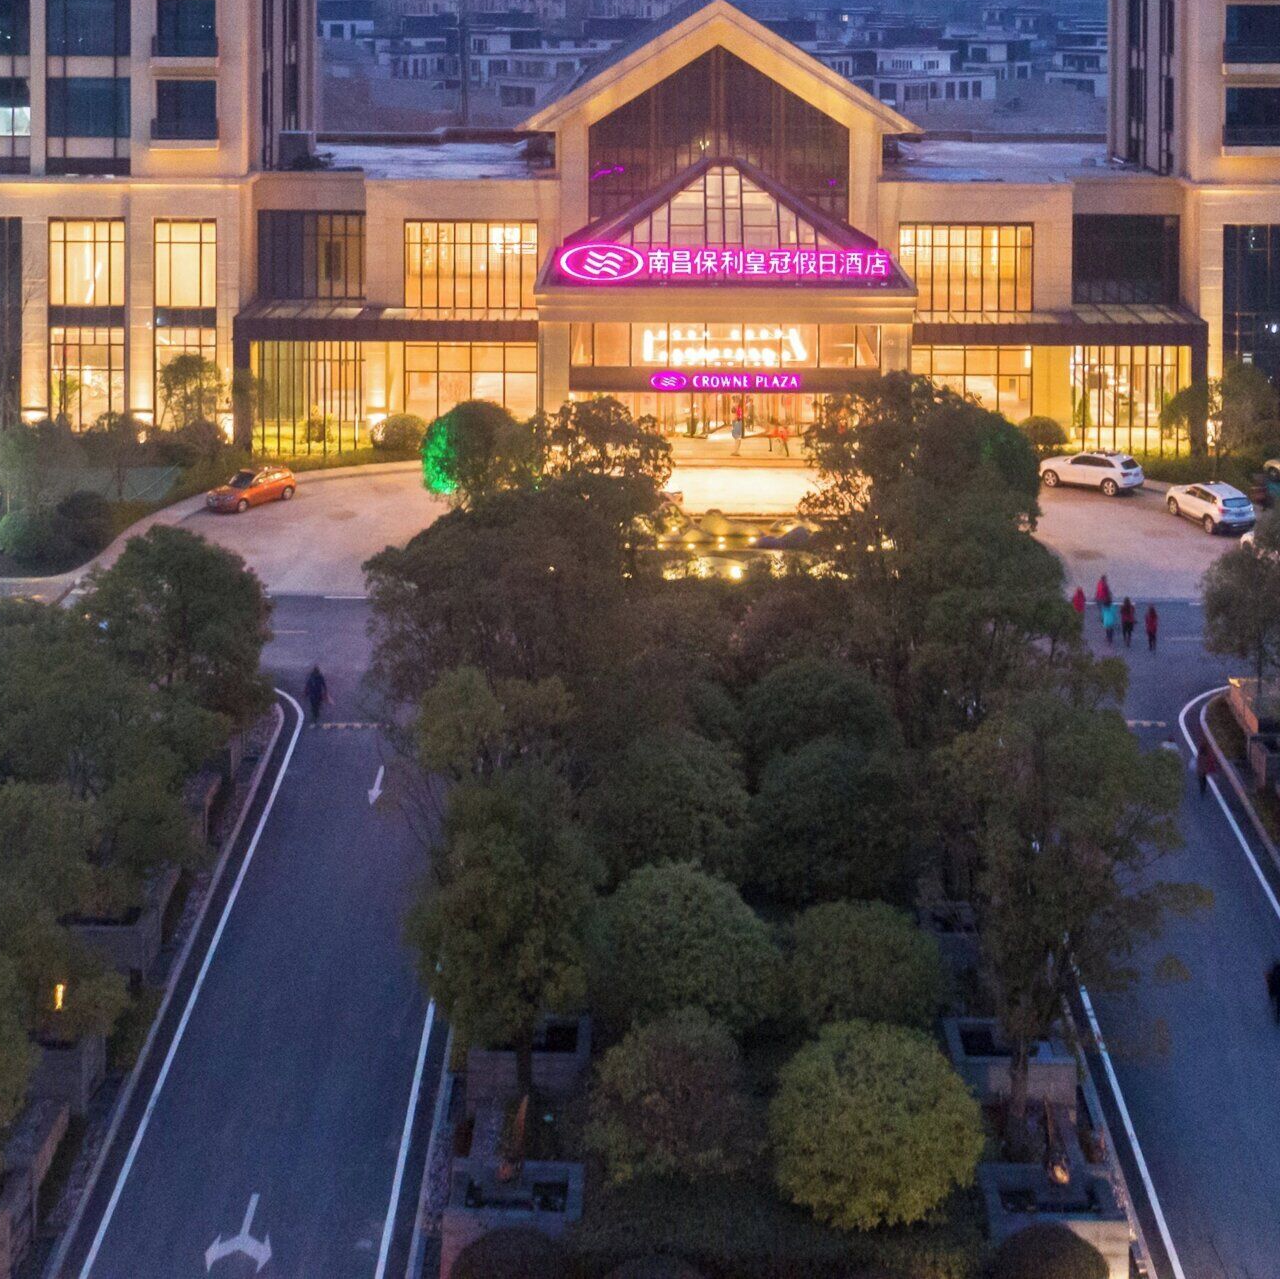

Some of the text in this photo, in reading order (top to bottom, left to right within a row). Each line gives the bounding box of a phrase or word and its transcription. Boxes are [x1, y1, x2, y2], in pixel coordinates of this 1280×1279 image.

[648, 250, 888, 276] 南昌保利皇冠假日酒店
[692, 375, 799, 388] CROWNE PLAZA
